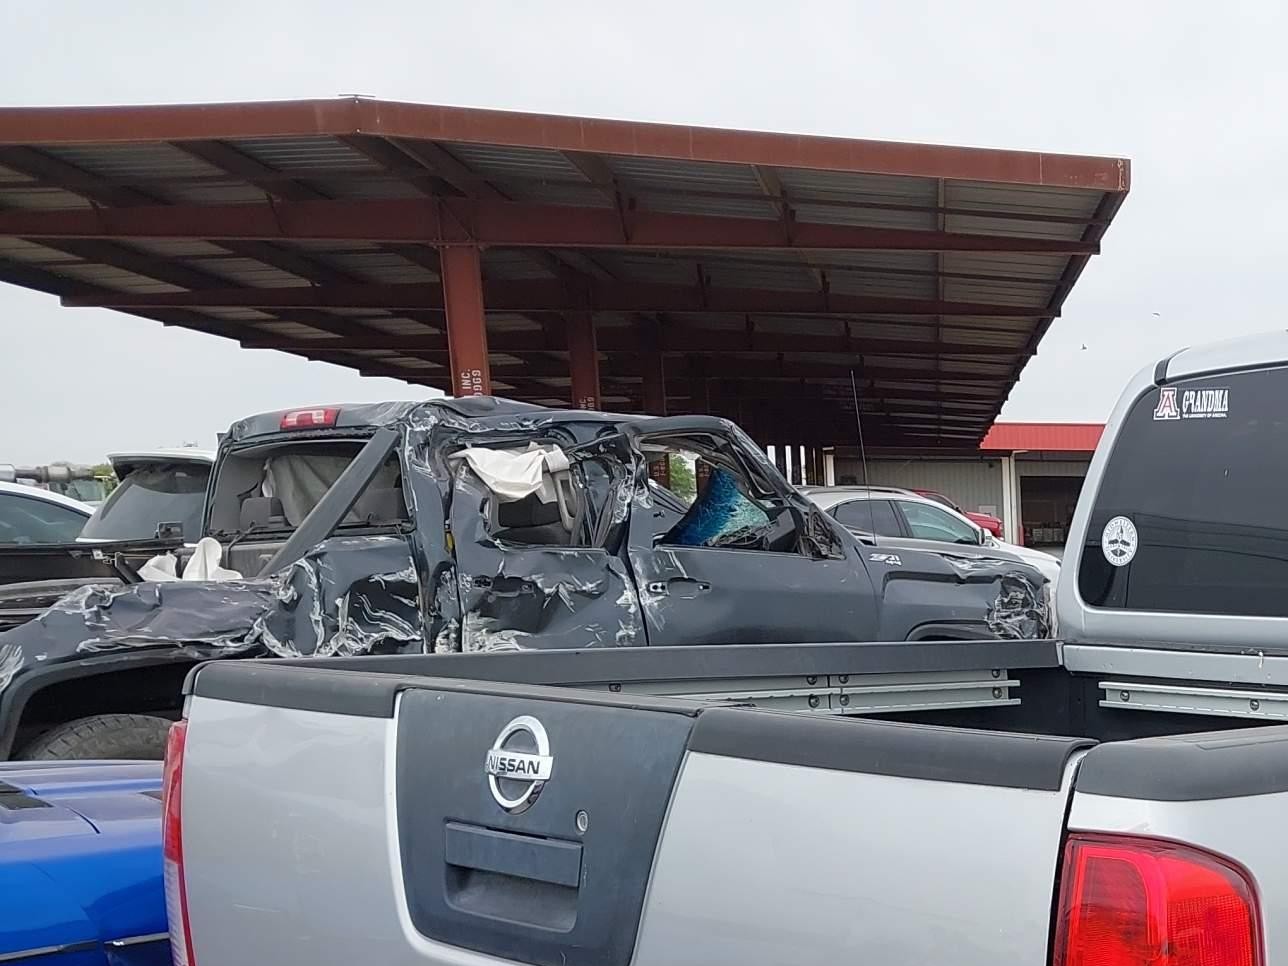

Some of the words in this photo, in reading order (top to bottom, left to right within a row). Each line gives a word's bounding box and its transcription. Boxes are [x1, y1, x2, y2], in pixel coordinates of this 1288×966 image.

[462, 369, 471, 389] INC.
[1182, 389, 1229, 413] GRANDMA
[488, 755, 541, 775] NISSAN
